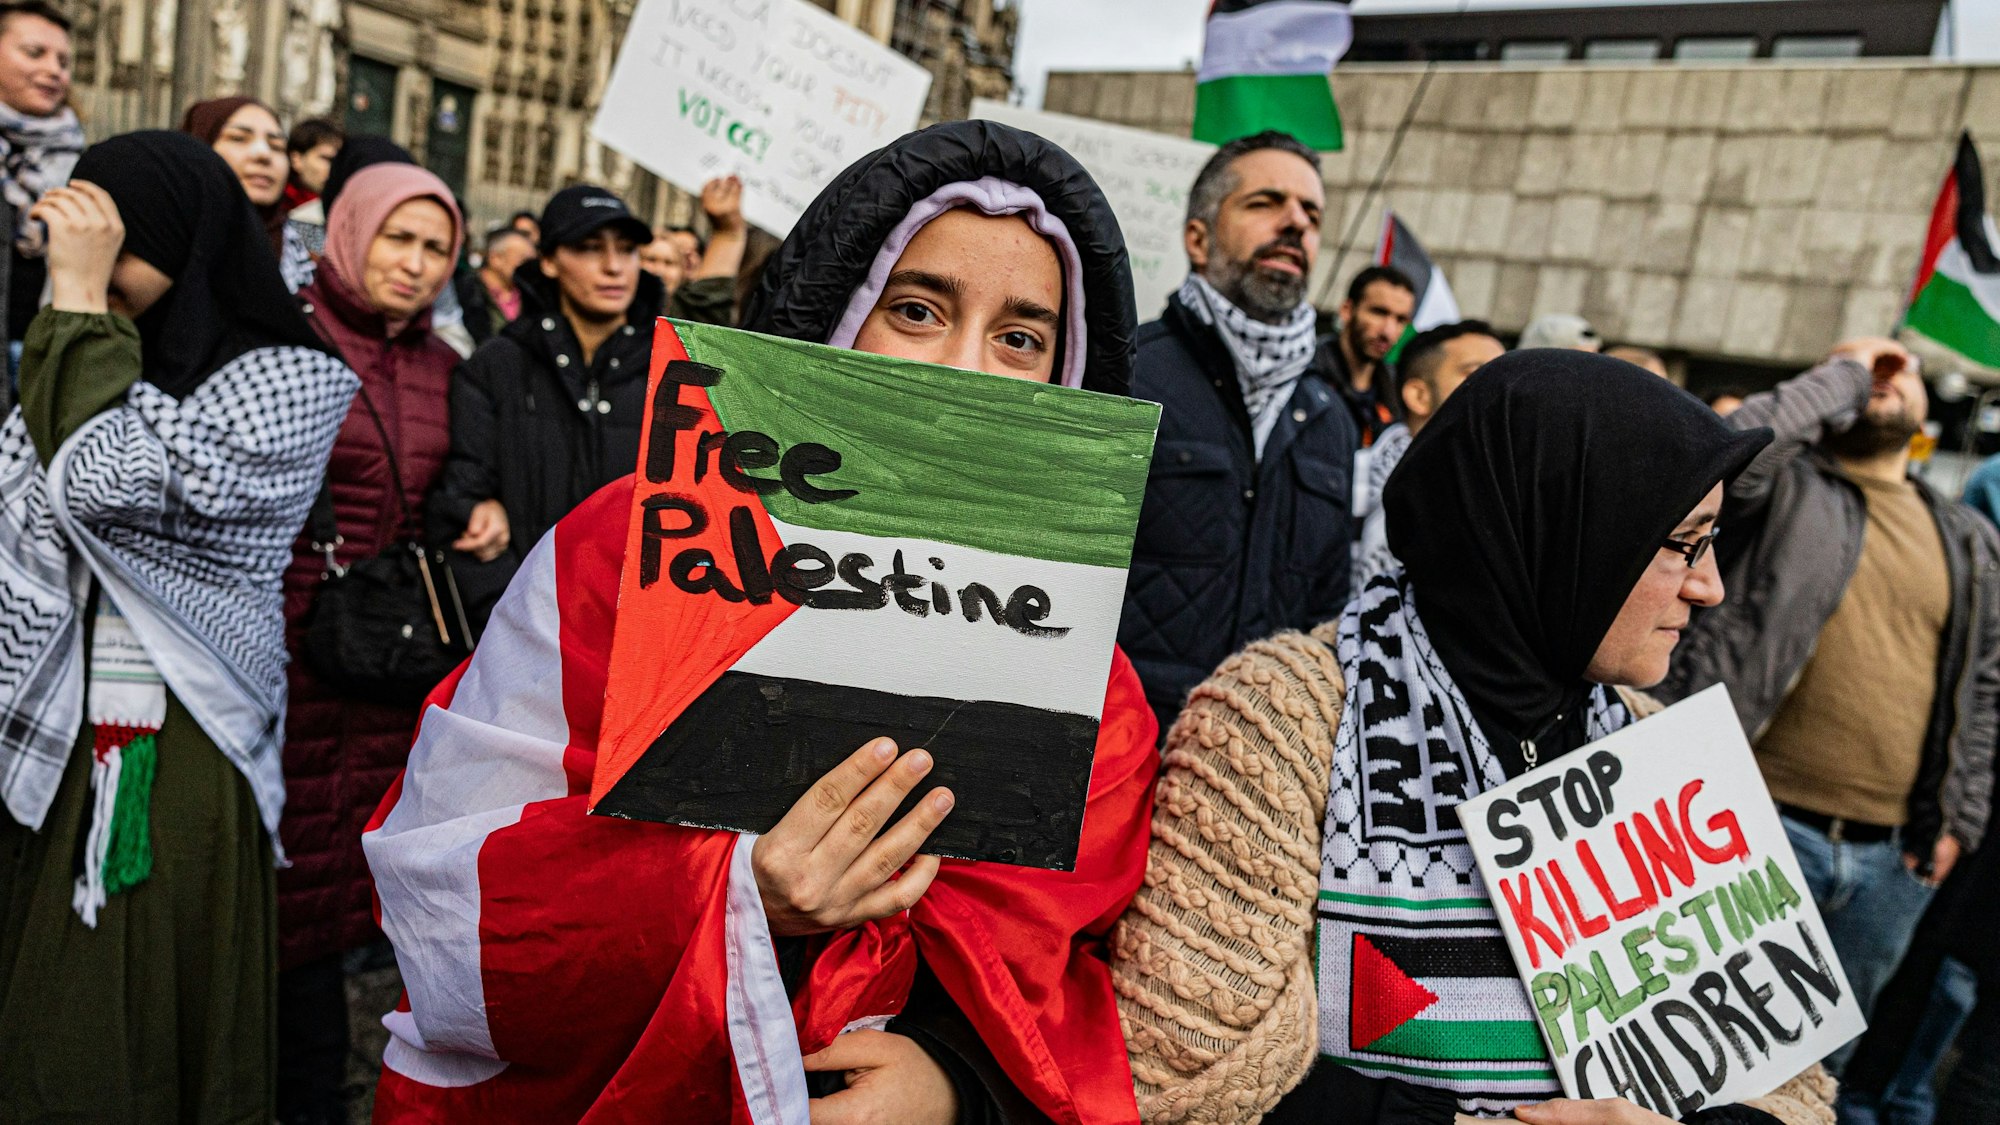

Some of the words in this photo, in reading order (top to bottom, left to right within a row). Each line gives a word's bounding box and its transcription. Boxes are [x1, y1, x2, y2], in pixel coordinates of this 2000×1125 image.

[651, 34, 685, 69] IT
[646, 360, 859, 503] Free
[640, 493, 1073, 638] Palestine
[1487, 750, 1623, 868] STOP
[1499, 778, 1751, 969] KILLING
[1574, 921, 1841, 1119] CHILDREN
